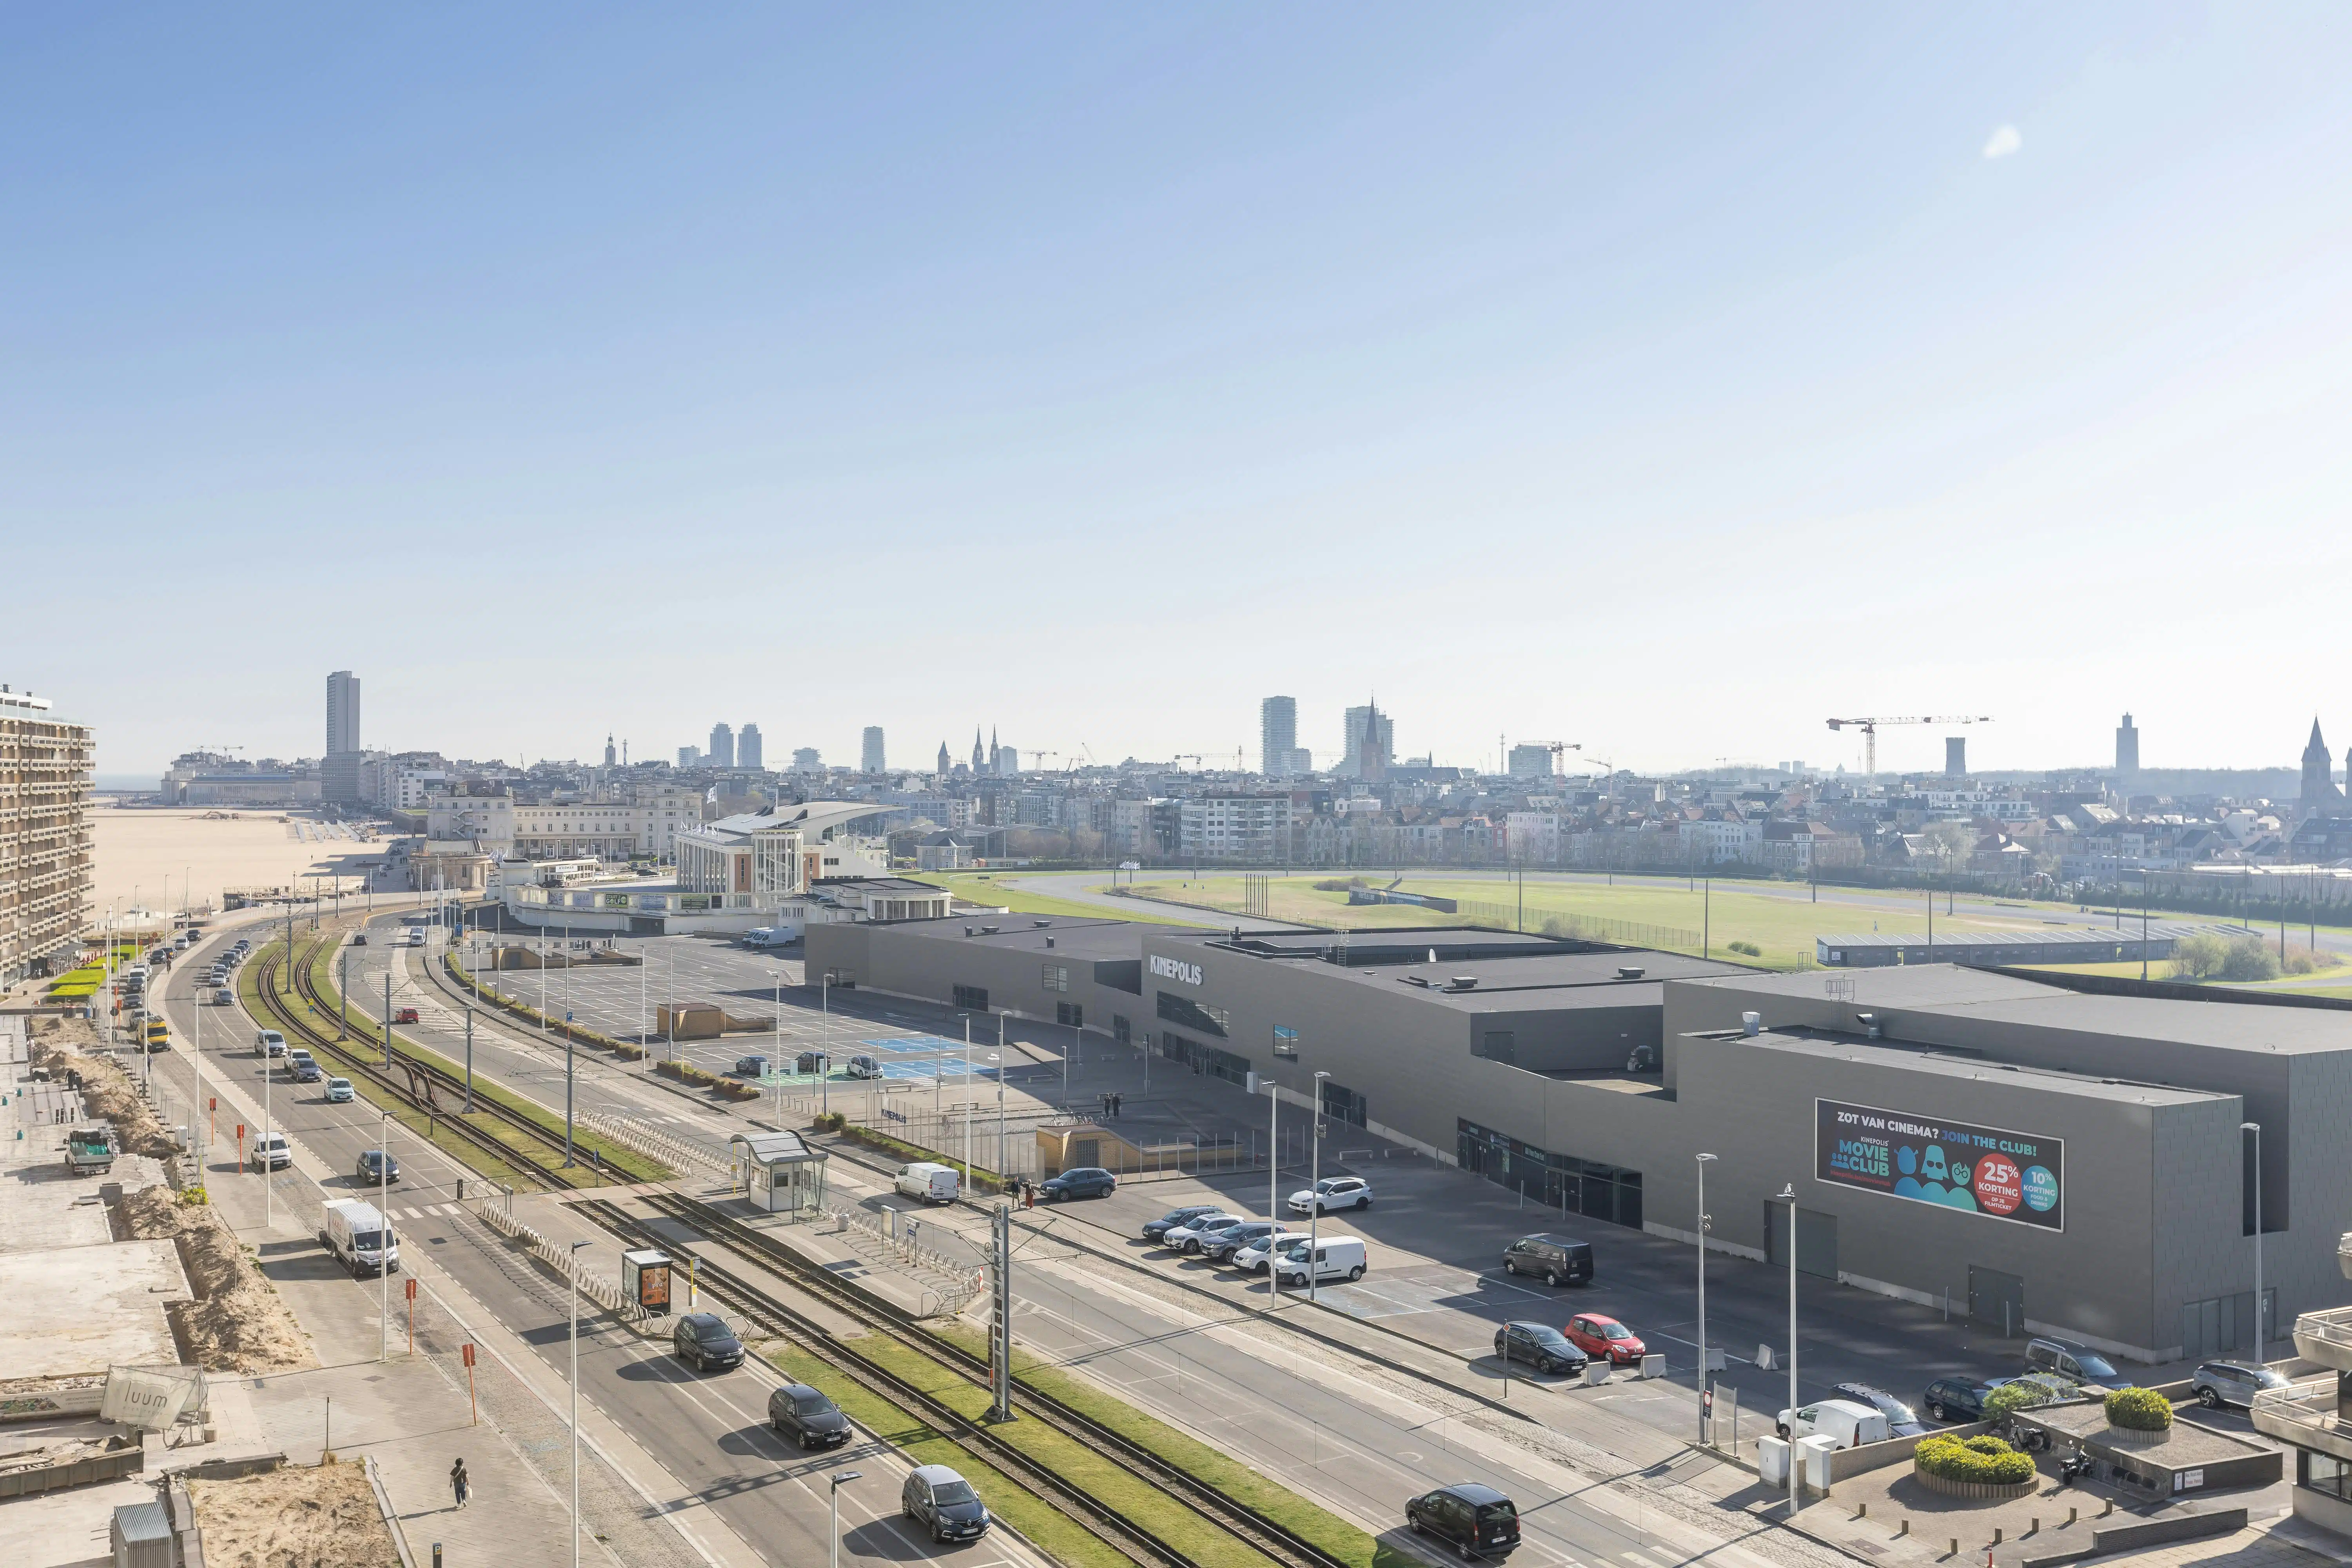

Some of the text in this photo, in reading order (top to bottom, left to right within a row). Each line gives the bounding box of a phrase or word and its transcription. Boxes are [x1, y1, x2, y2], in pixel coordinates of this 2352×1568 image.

[1150, 955, 1203, 985] KINEPOLIS
[882, 1108, 906, 1124] KINEPOLIS
[1837, 1111, 2037, 1156] ZOT VAN CINEMA? JOIN THE CLUB!
[1839, 1139, 1888, 1161] MOVIE
[1849, 1156, 1889, 1176] CLUB
[1984, 1162, 2018, 1183] 25%
[2031, 1171, 2052, 1185] 10%
[1978, 1182, 2018, 1197] KORTING
[2024, 1185, 2055, 1196] KORTING
[1984, 1201, 2012, 1210] FILMTICKET
[125, 1381, 167, 1408] luum
